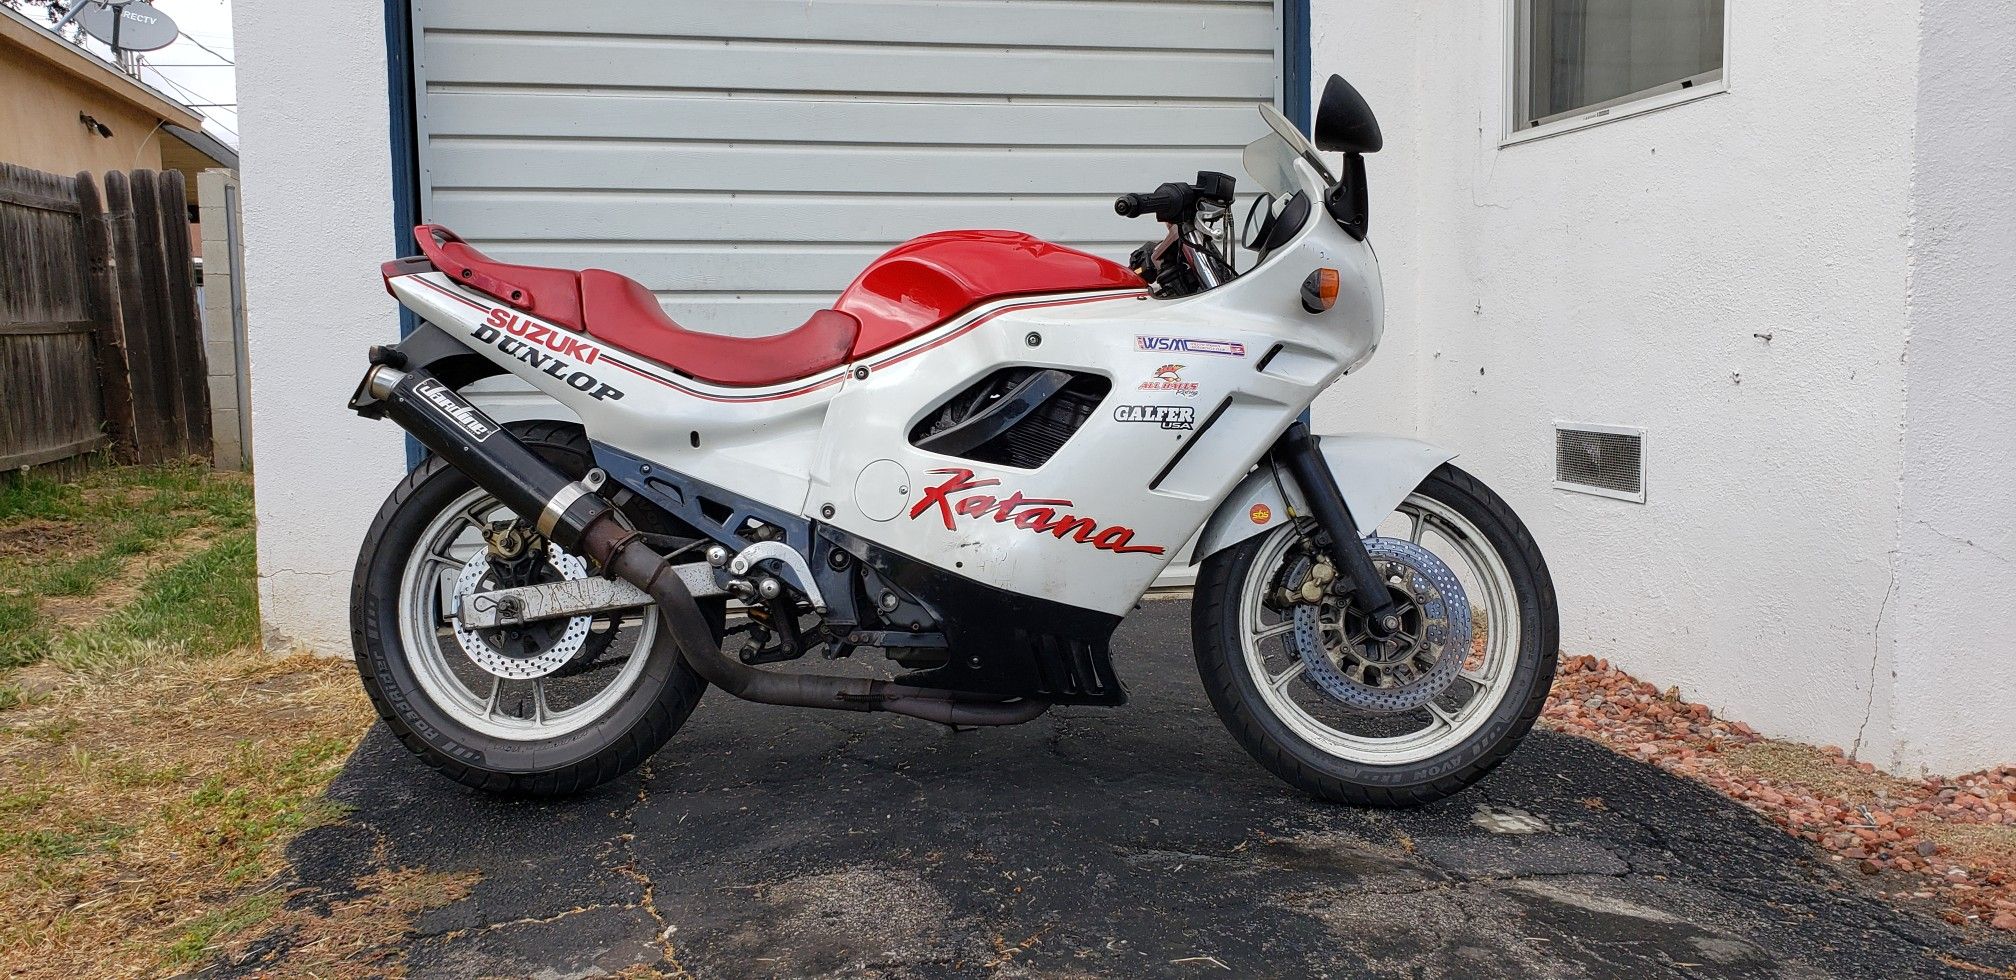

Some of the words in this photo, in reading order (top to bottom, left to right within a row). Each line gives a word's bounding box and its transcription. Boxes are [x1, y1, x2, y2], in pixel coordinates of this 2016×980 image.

[122, 10, 157, 24] RECTV
[486, 308, 600, 366] SUZUKI
[470, 323, 625, 401] DUNLOP
[1138, 382, 1161, 391] ALL
[1114, 405, 1194, 422] GALFER
[1161, 422, 1193, 430] USA
[909, 468, 1166, 555] Katana
[1413, 755, 1463, 782] AVON
